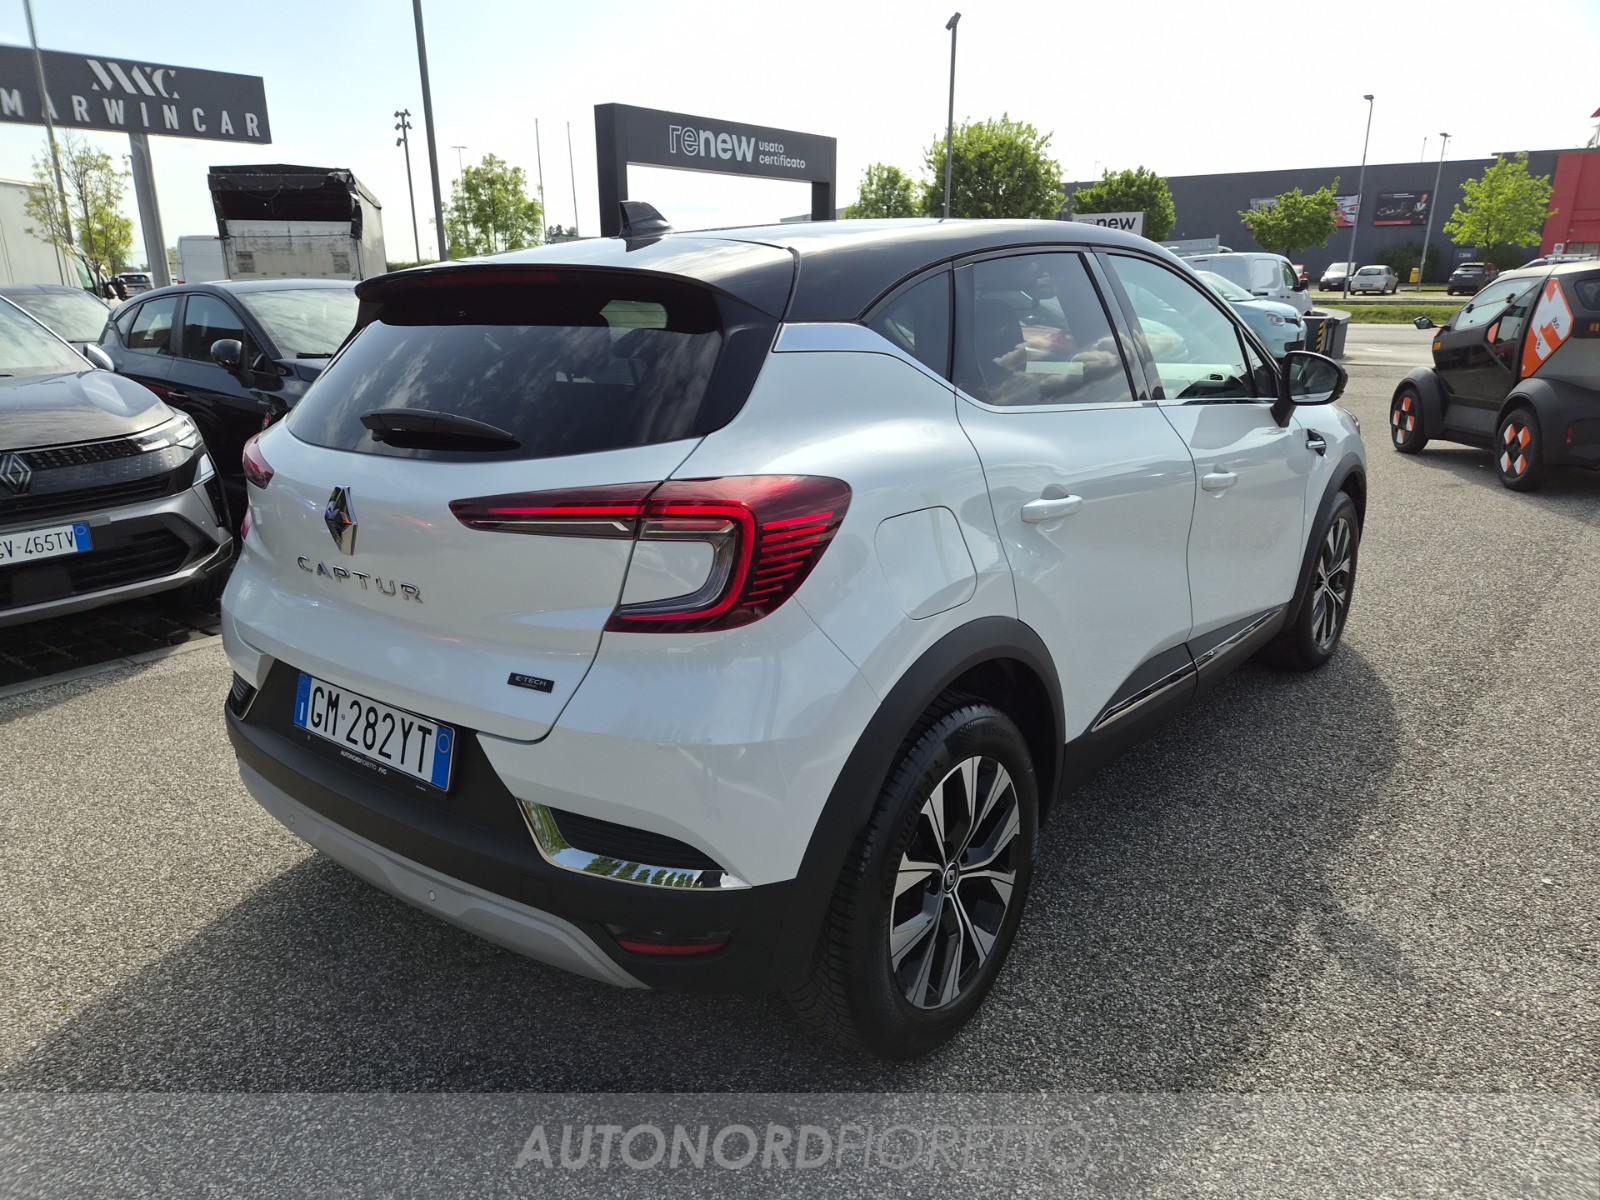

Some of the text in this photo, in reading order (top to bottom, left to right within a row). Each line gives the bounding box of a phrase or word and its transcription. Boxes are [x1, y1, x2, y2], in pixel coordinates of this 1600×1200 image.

[0, 88, 261, 137] MARWINCAR
[669, 125, 756, 162] renew
[759, 141, 785, 153] usato
[759, 155, 806, 169] certificato
[297, 554, 423, 603] CAPTUR
